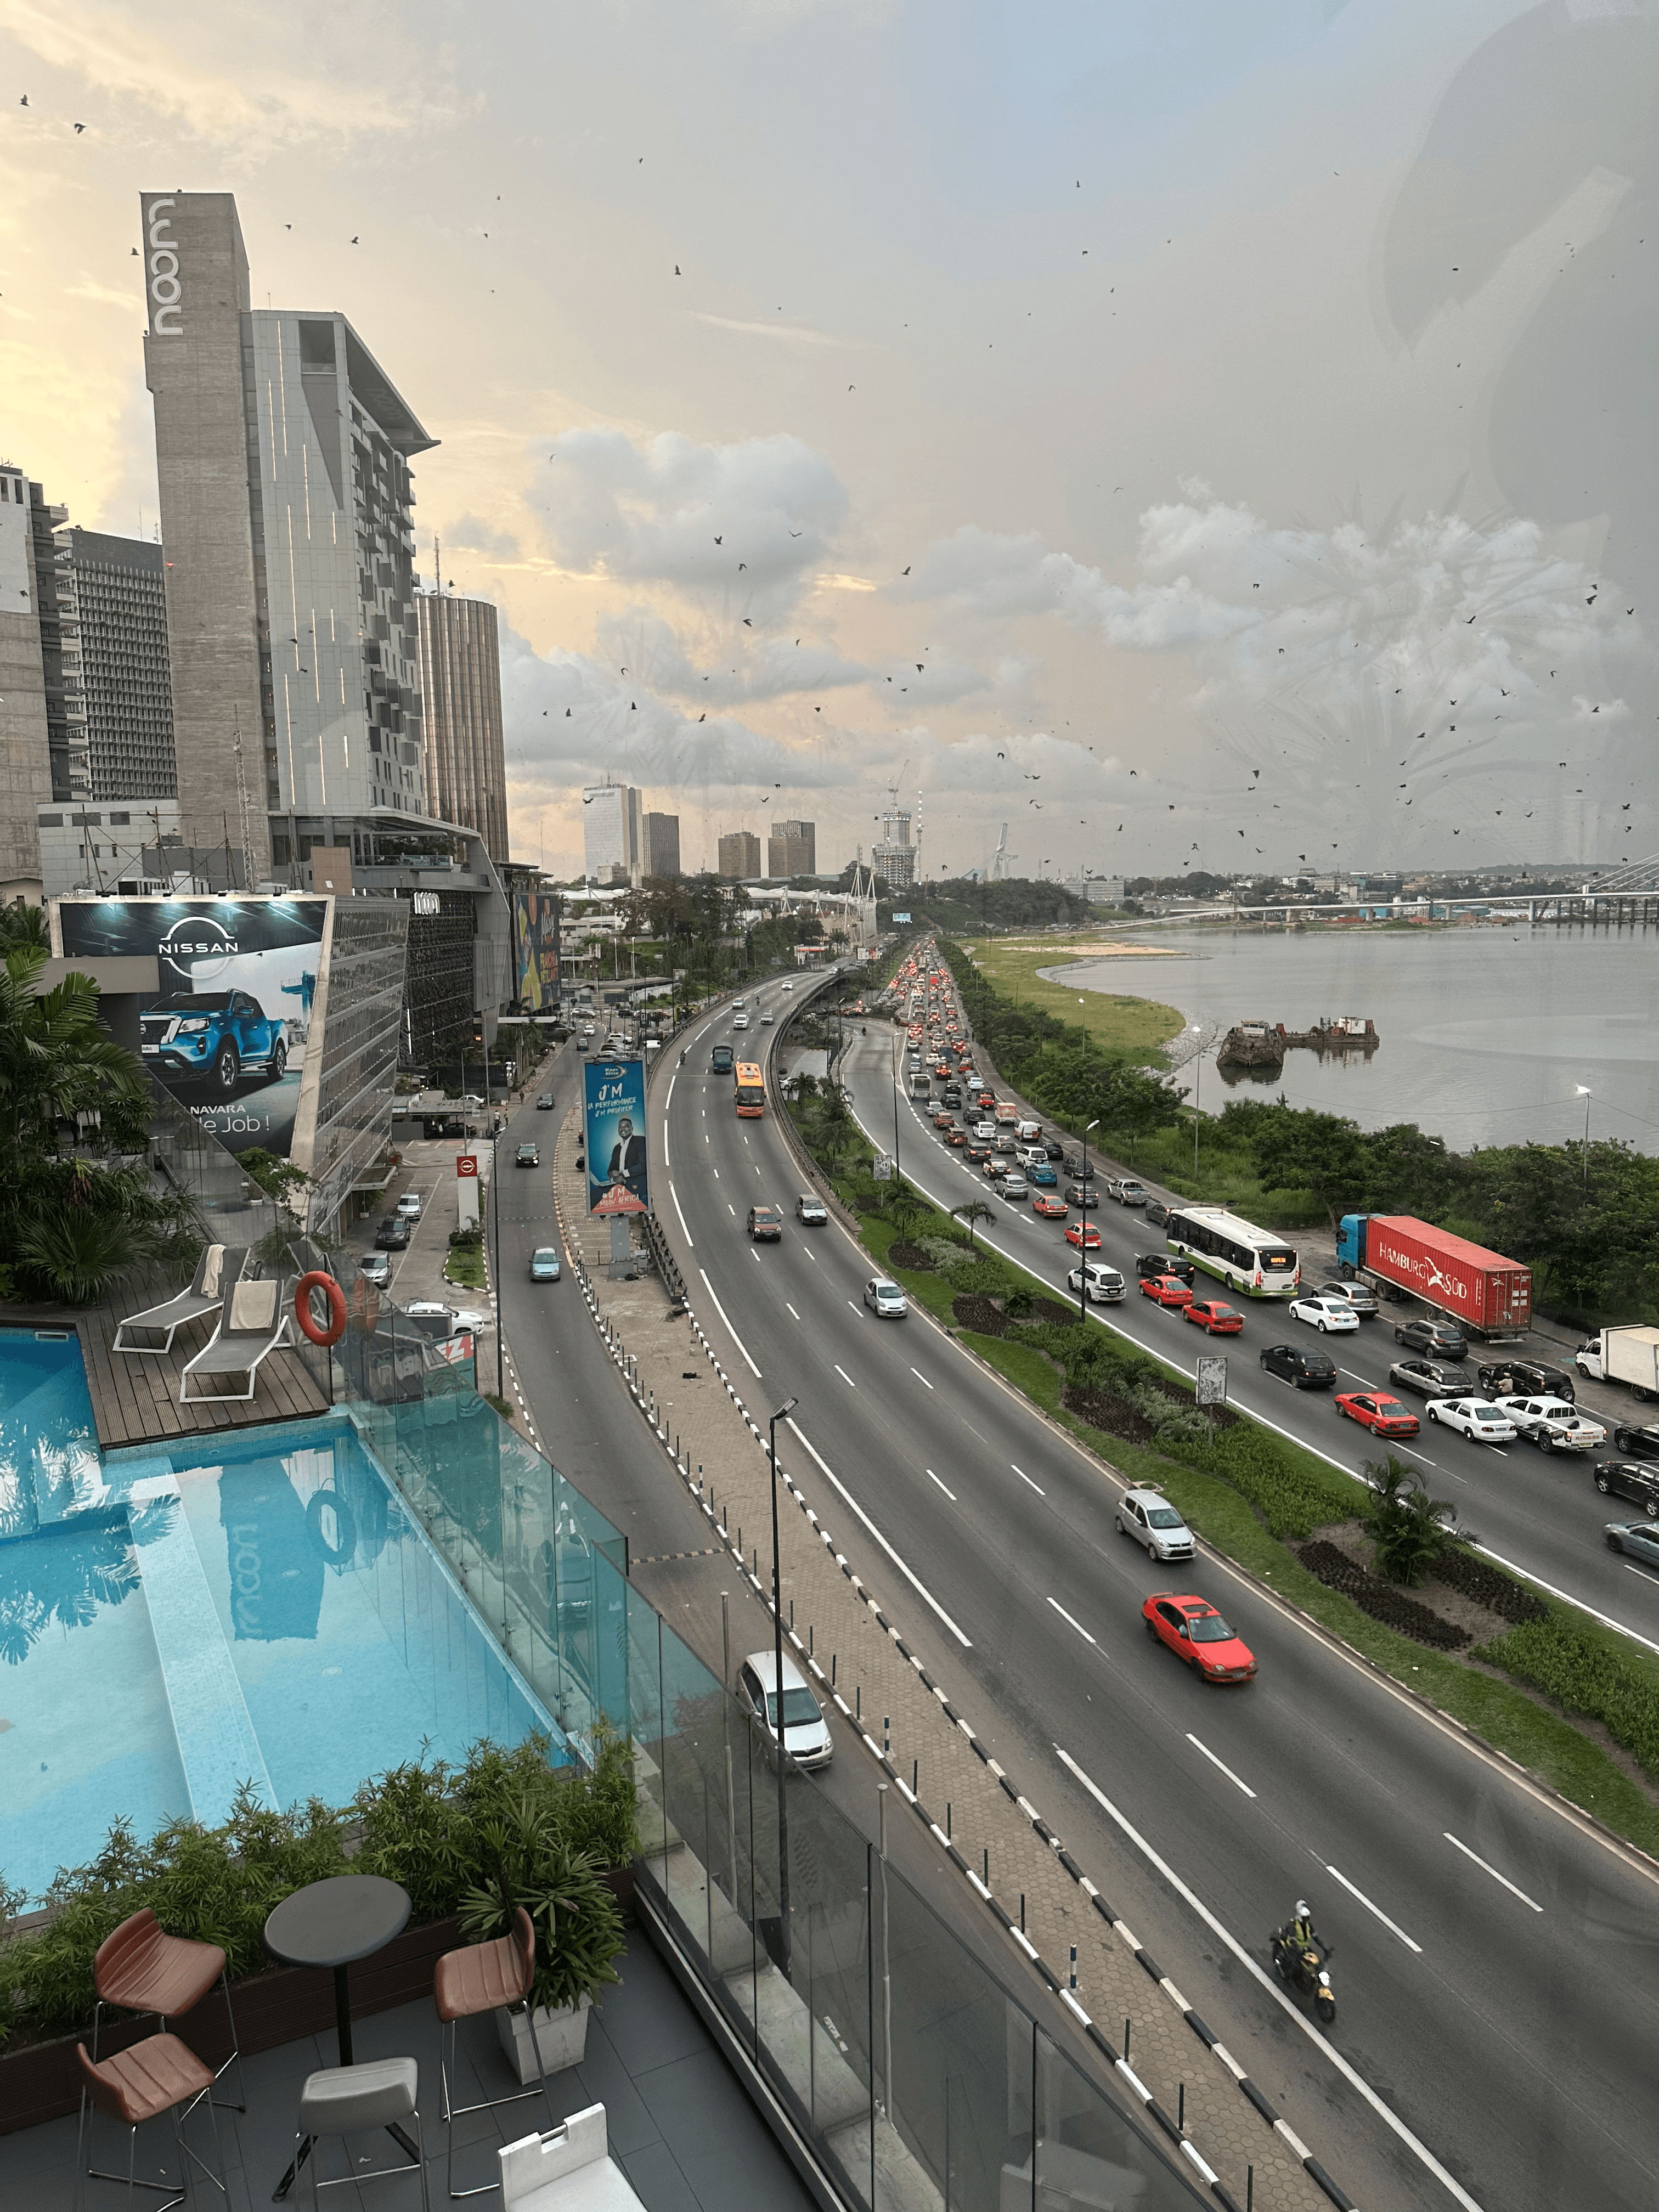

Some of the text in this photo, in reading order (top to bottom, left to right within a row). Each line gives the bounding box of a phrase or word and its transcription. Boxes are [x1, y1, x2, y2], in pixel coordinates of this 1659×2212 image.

[149, 199, 183, 336] noom
[159, 942, 239, 954] NISSAN
[190, 1104, 246, 1114] NAVARA
[595, 1096, 636, 1110] PERFORMANCE
[607, 1105, 633, 1115] PROFITER
[221, 1115, 261, 1132] Job
[600, 1193, 640, 1206] MOOV AFRICA
[1380, 1242, 1426, 1279] HAMBURG
[1445, 1273, 1467, 1299] SÜD
